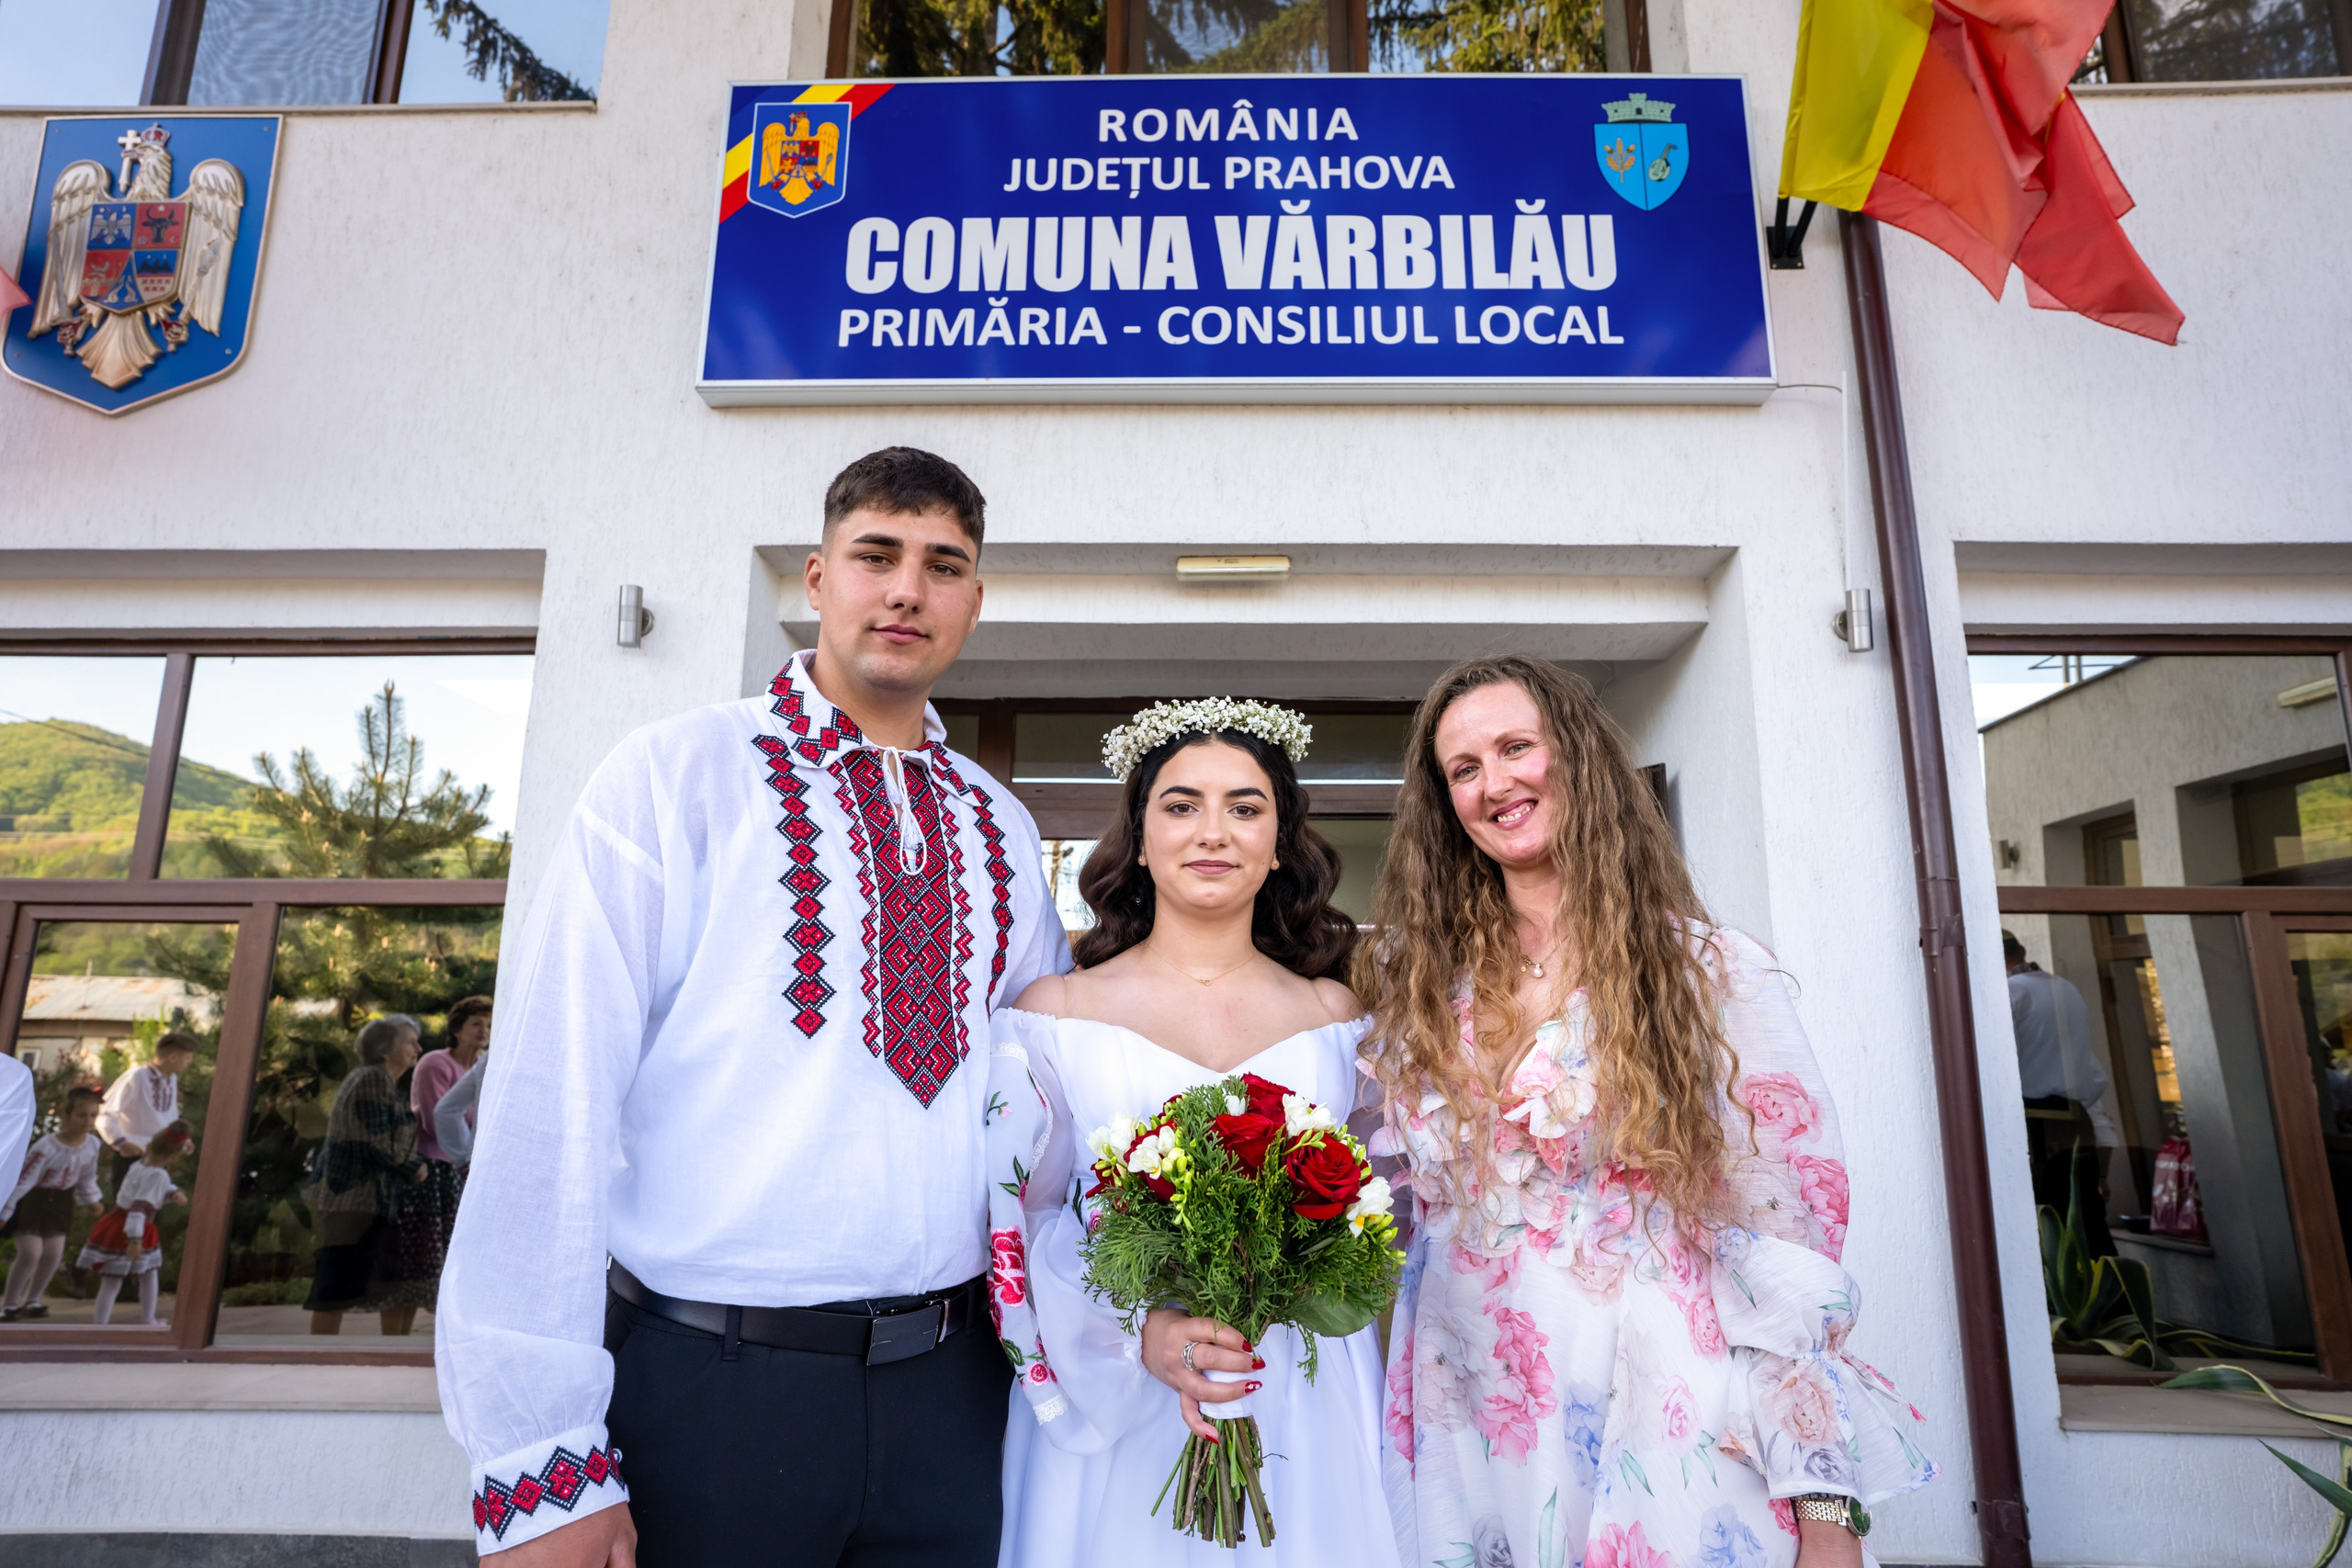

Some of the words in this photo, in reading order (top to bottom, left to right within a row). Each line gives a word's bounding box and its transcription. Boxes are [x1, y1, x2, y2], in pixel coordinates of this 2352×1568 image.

[1098, 99, 1359, 142] ROMÂNIA
[1003, 156, 1211, 199] JUDEȚUL
[1225, 156, 1455, 192] PRAHOVA
[846, 215, 1198, 295] COMUNA
[1215, 199, 1617, 291] VĂRBILĂU
[838, 297, 1108, 347] PRIMĂRIA
[1158, 306, 1439, 346] CONSILIUL
[1455, 305, 1624, 345] LOCAL
